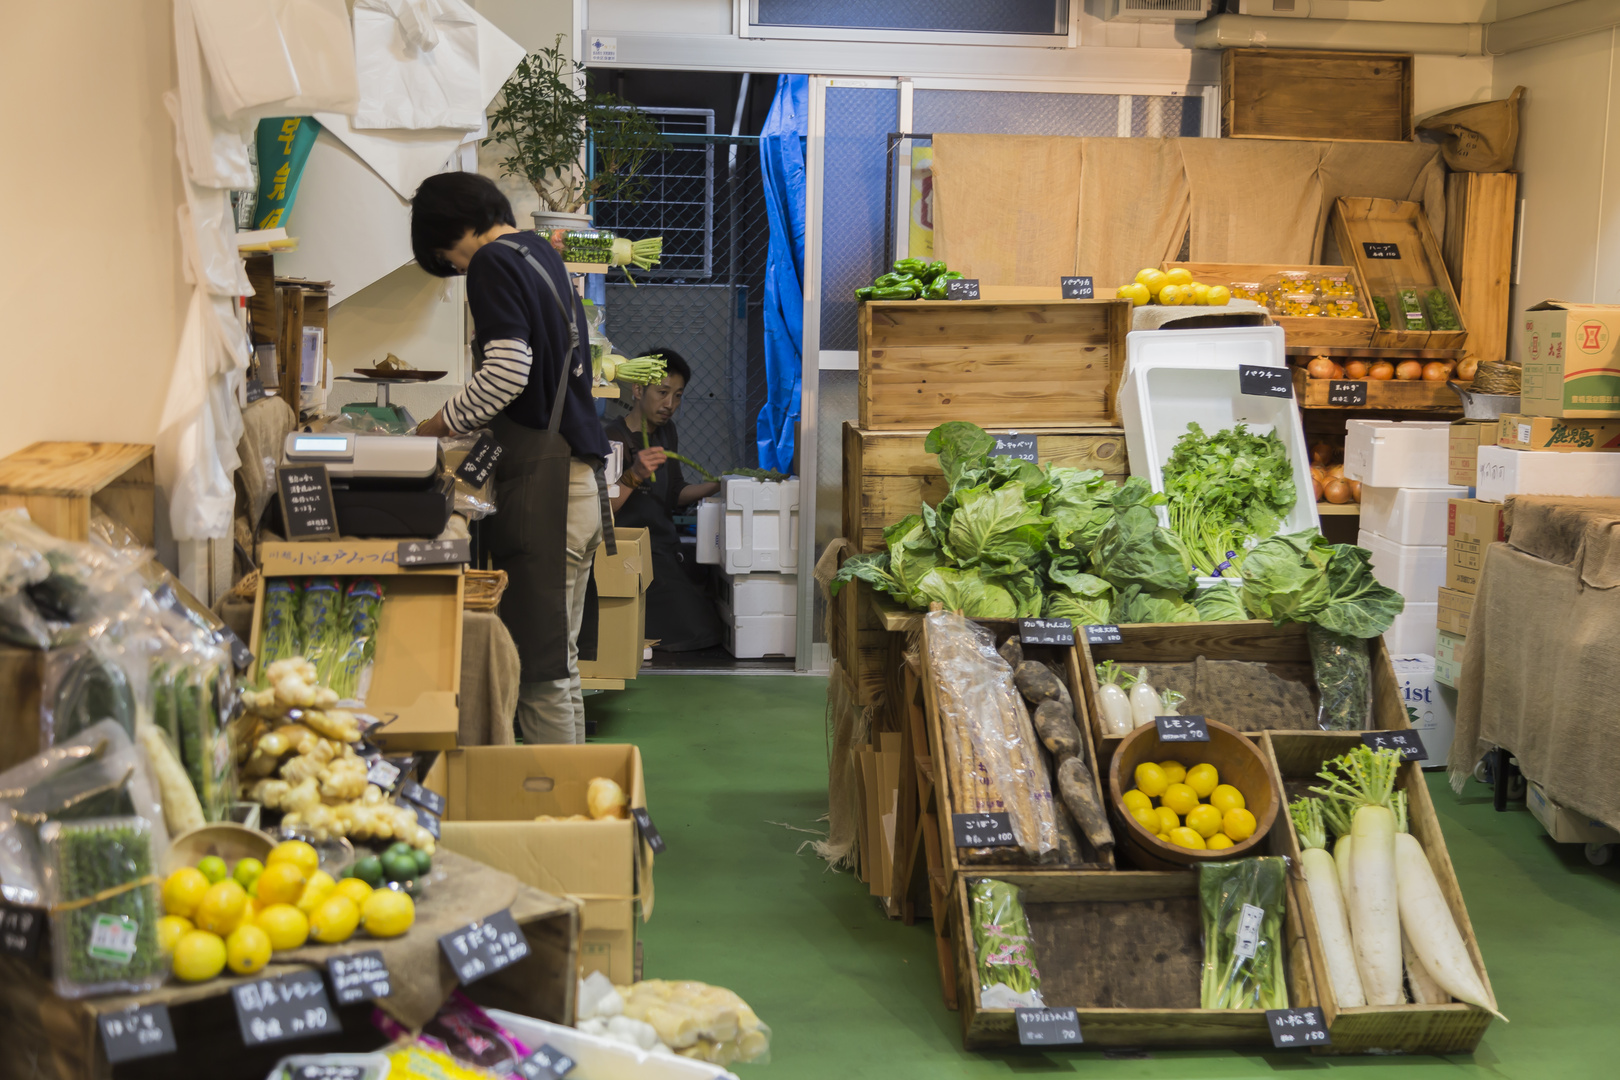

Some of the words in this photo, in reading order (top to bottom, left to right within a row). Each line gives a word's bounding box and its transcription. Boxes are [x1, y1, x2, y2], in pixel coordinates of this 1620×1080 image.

[951, 282, 977, 291] ピーマン
[1063, 278, 1090, 287] パプリカ
[1245, 370, 1282, 379] パクチー
[1543, 423, 1595, 448] 鹿児島
[995, 439, 1033, 450] 春キャベツ
[490, 446, 503, 461] 450
[1024, 620, 1071, 629] 加賀れんこん
[1056, 634, 1073, 642] 130
[1399, 680, 1433, 704] ist
[1163, 719, 1196, 729] レモン
[1189, 729, 1204, 738] 70
[1374, 735, 1408, 747] 大根
[965, 819, 999, 830] ごぼう
[997, 832, 1013, 841] 100
[1275, 1011, 1318, 1027] 小松菜
[1061, 1029, 1076, 1040] 70
[1305, 1030, 1325, 1041] 150
